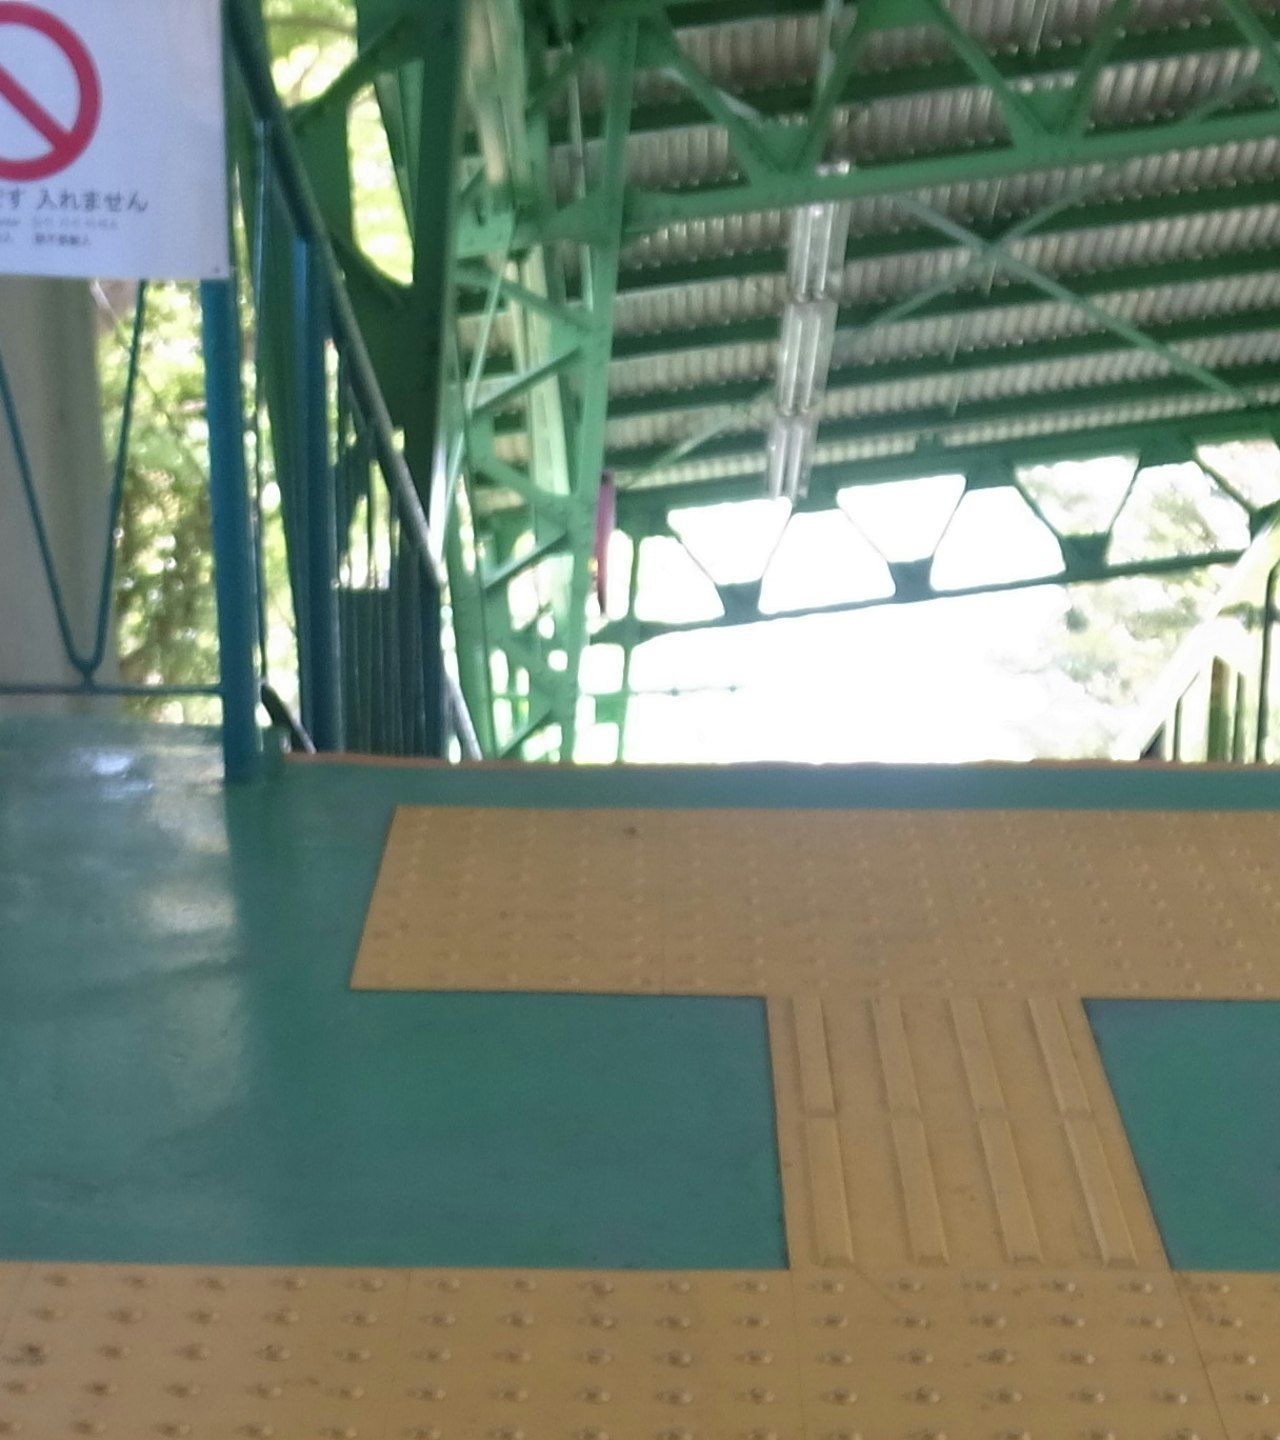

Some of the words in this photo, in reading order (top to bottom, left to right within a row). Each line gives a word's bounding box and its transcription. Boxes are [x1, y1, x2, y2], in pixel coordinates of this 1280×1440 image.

[36, 188, 148, 213] 入れません
